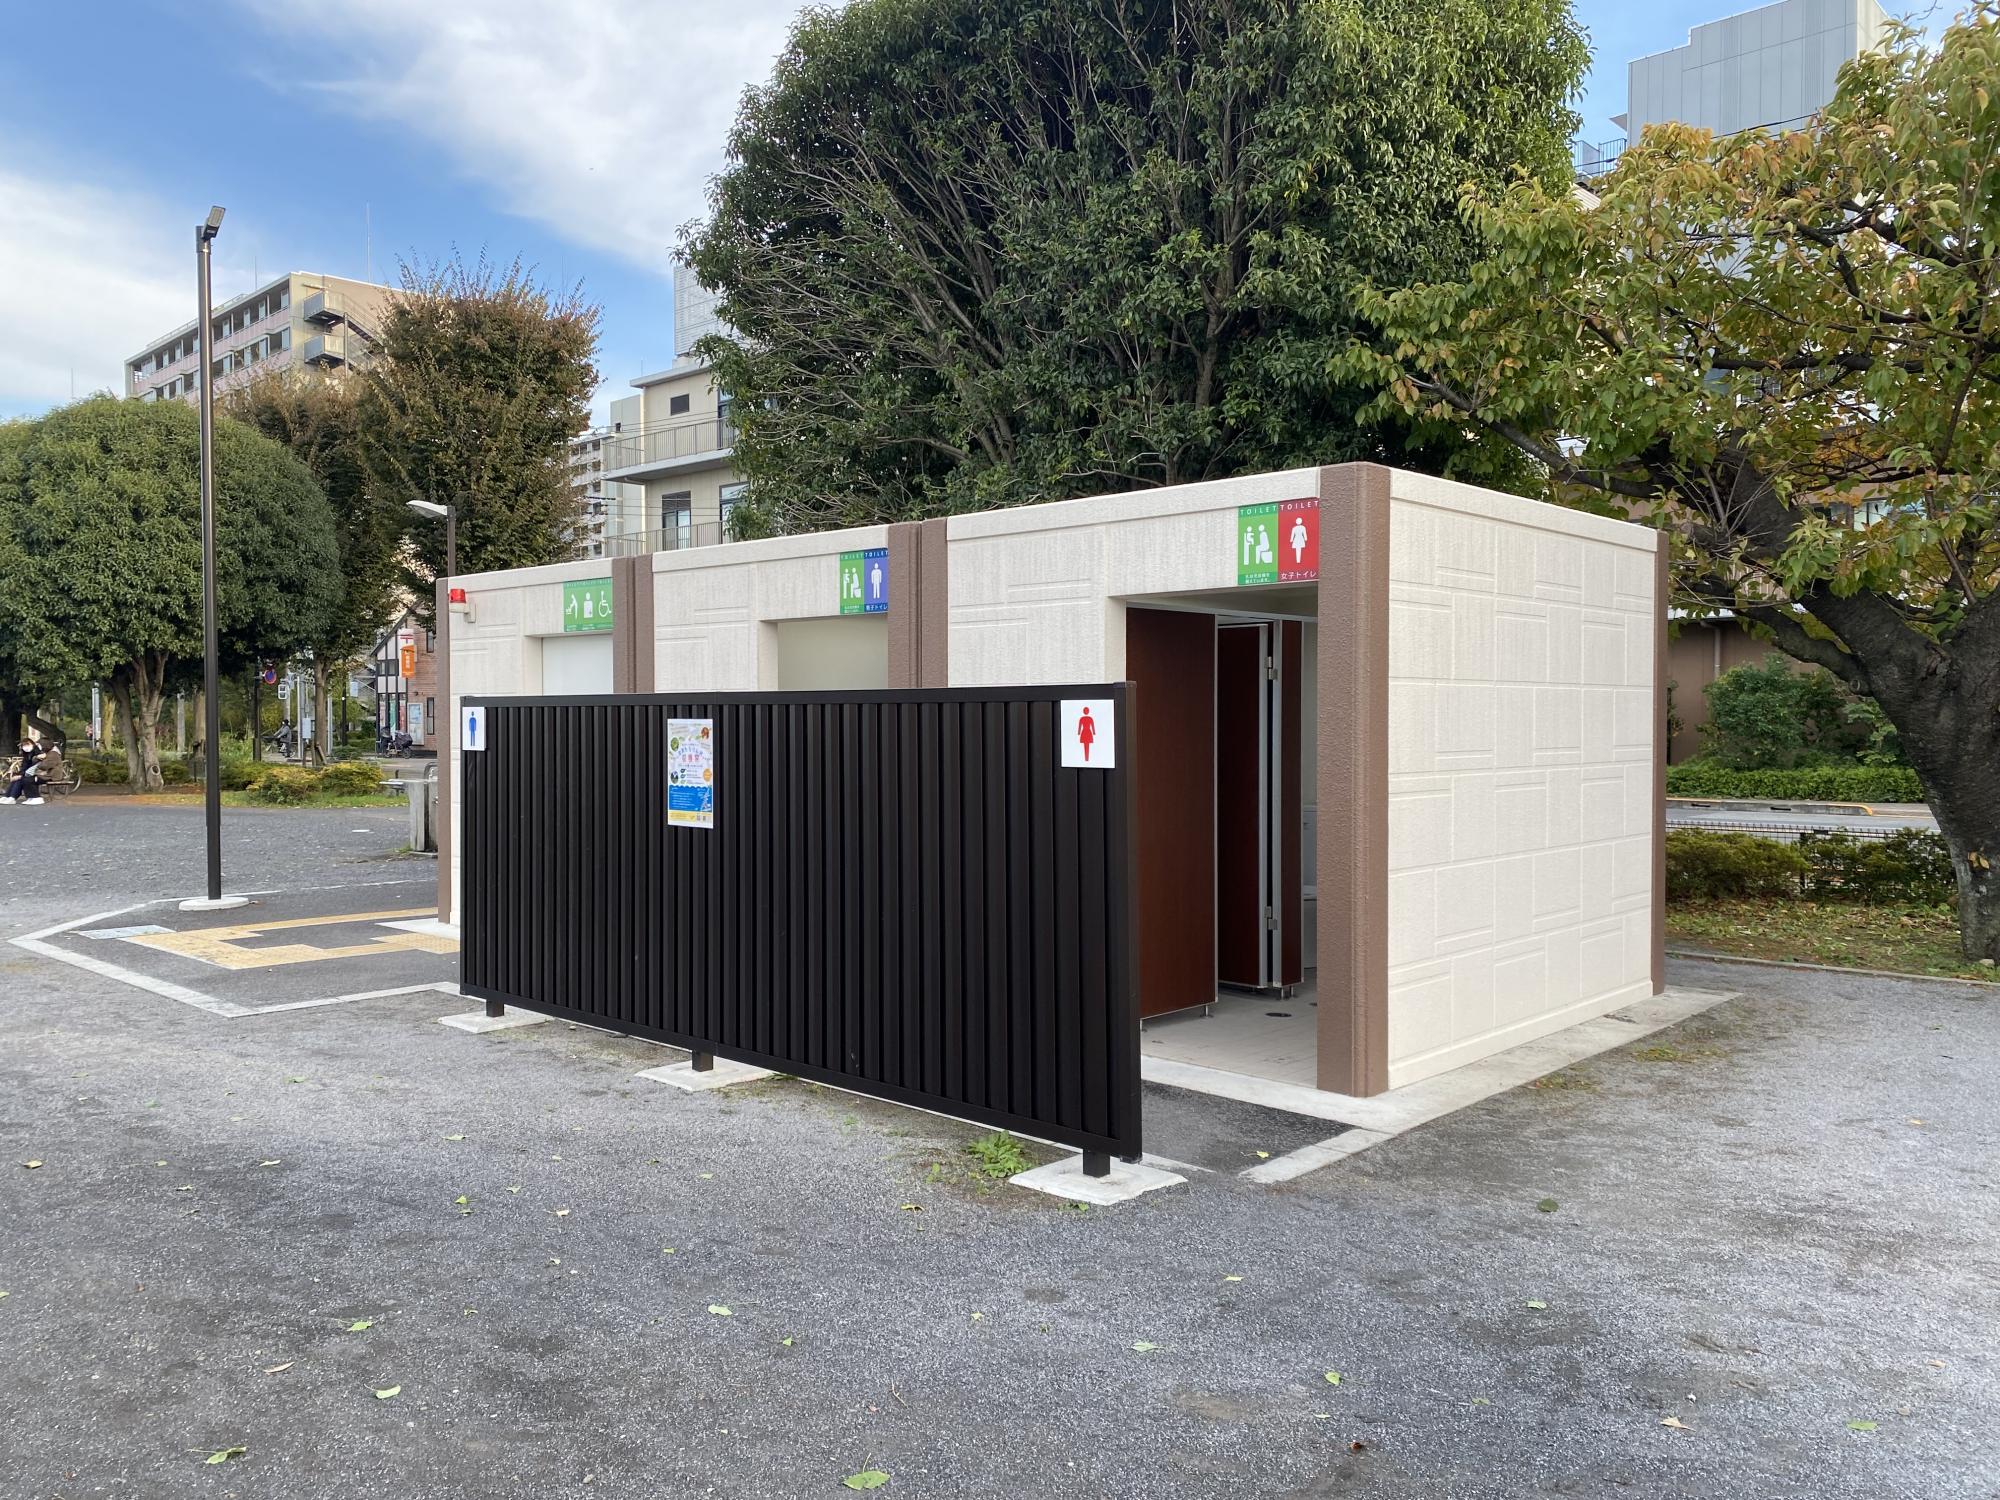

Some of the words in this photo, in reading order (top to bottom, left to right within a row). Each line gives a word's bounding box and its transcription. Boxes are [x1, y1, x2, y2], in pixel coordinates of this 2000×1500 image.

[1240, 506, 1277, 515] TOILET
[1280, 501, 1319, 511] TOILET
[1281, 571, 1317, 580] 女子トイレ
